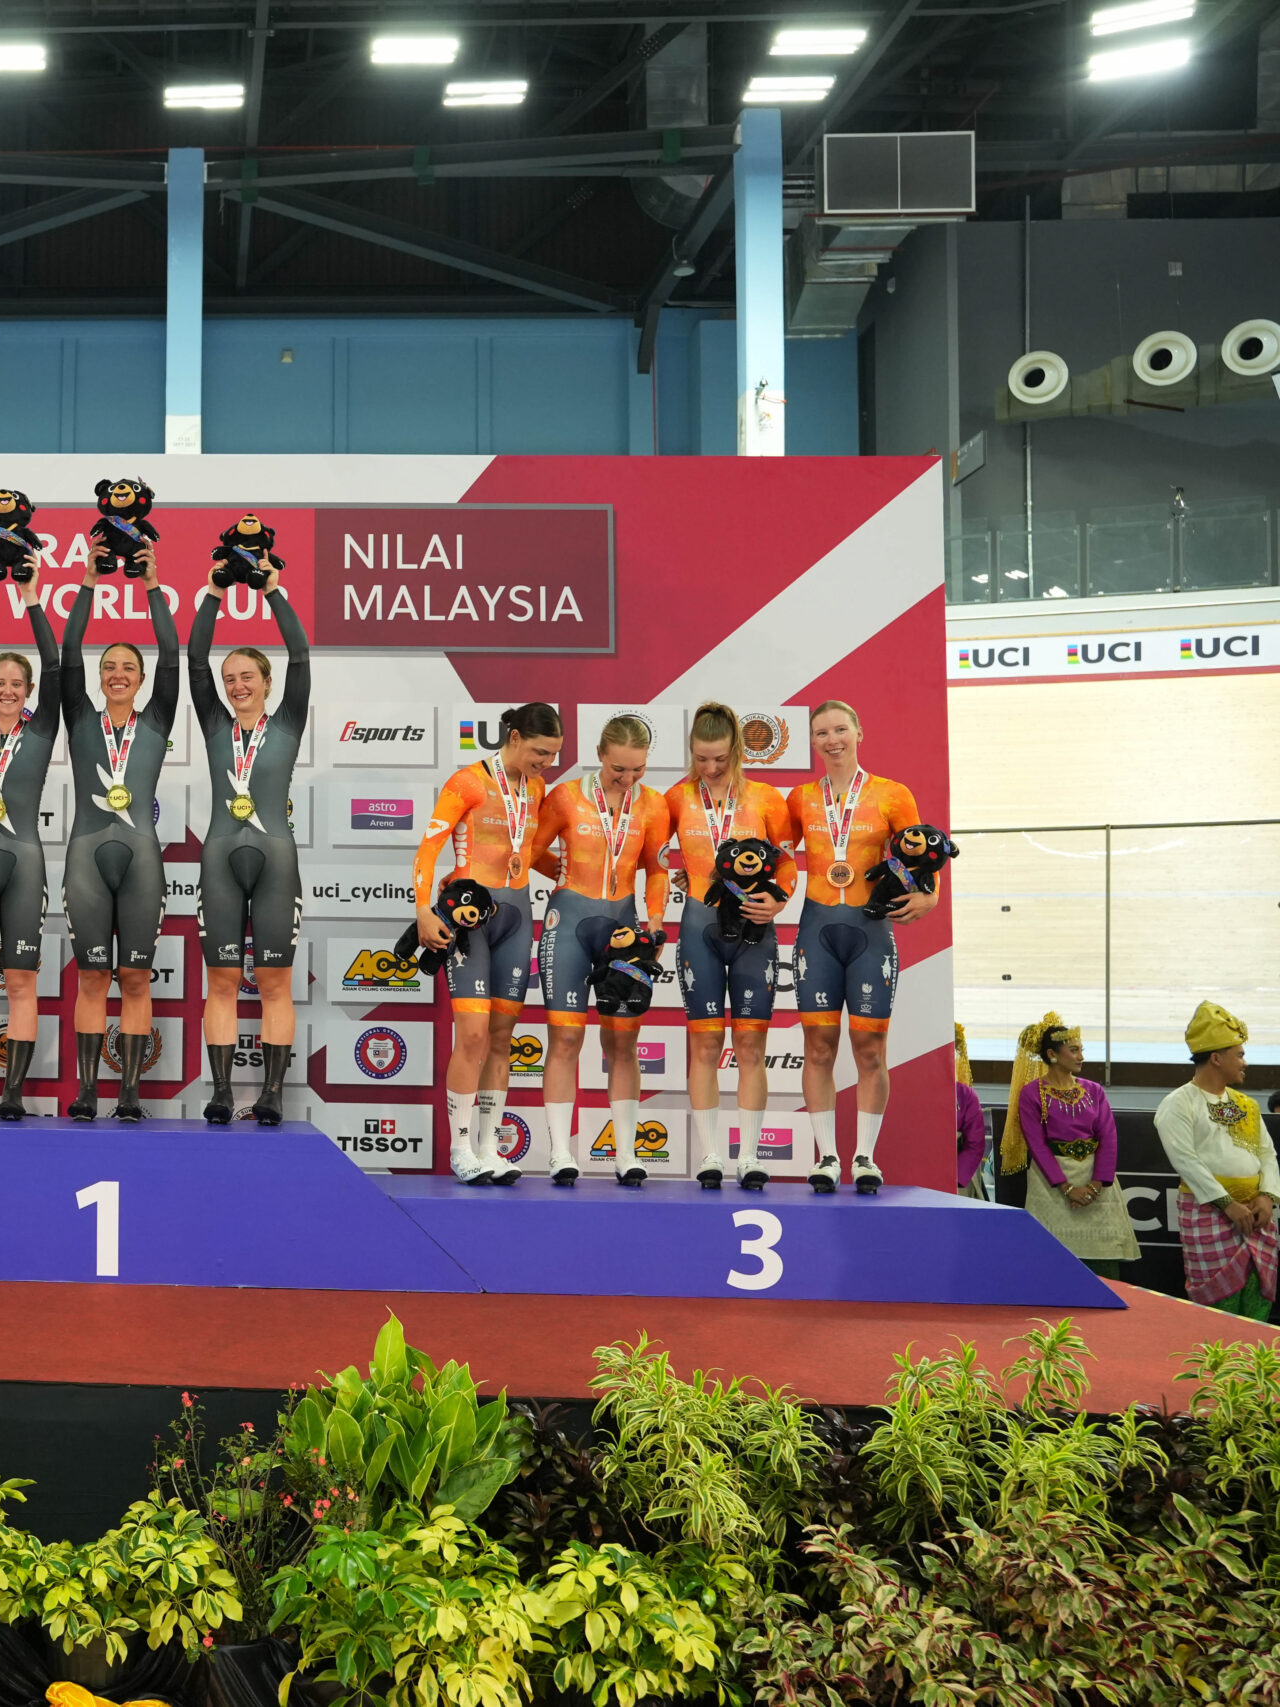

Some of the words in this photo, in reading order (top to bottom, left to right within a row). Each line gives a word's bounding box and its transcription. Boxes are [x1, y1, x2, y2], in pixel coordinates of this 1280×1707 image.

[343, 533, 463, 570] NILAI
[343, 584, 584, 623] MALAYSIA
[972, 646, 1030, 668] UCI
[1081, 641, 1142, 664] UCI
[1194, 635, 1260, 659] UCI
[368, 801, 397, 812] astro
[370, 819, 394, 827] Arena
[545, 930, 558, 1000] NEDERLANDSE
[337, 1136, 423, 1153] TISSOT
[1122, 1186, 1181, 1232] CI
[75, 1180, 120, 1277] 1
[726, 1207, 785, 1291] 3
